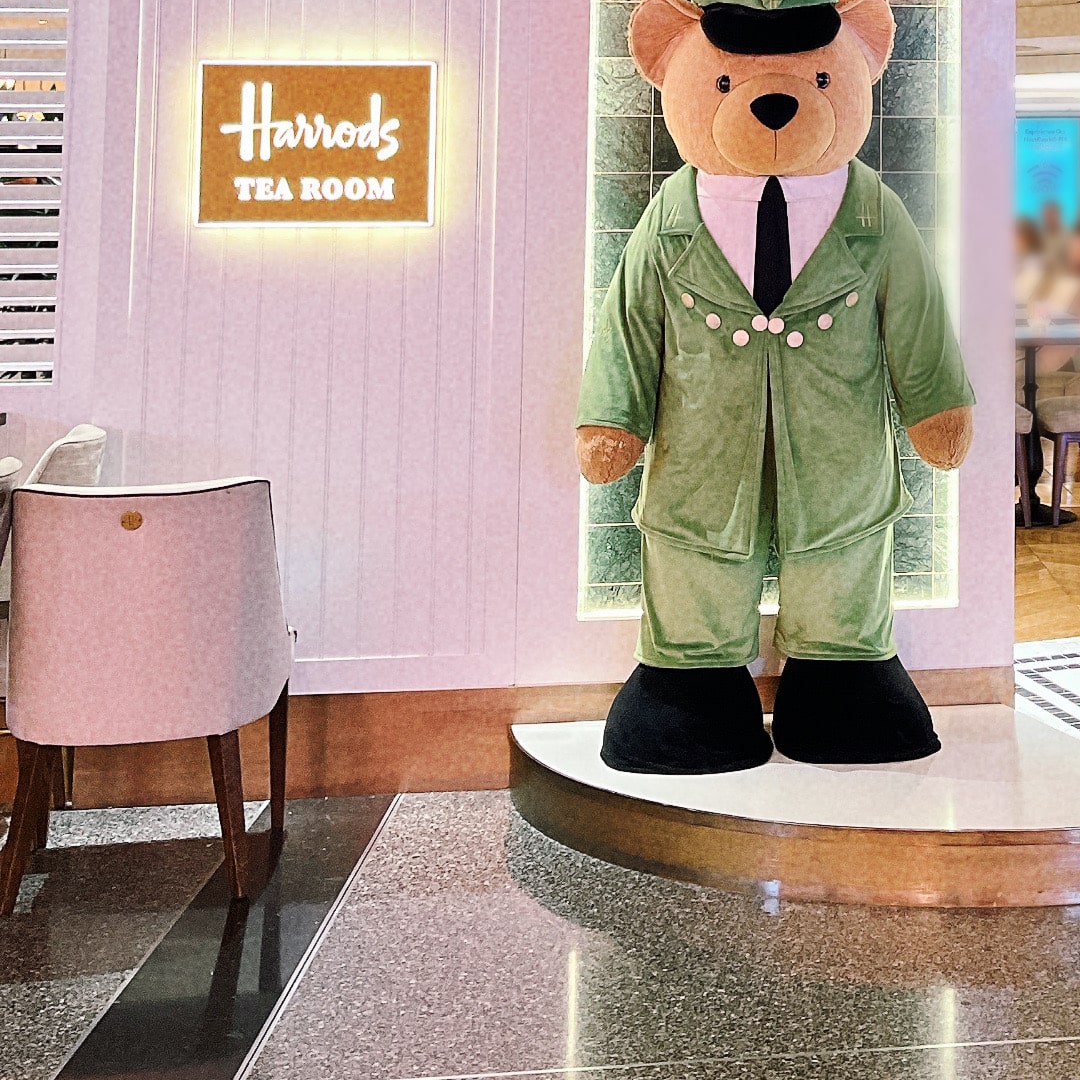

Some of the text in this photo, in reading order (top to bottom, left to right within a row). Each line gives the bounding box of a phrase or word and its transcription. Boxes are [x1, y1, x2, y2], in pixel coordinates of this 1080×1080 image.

[220, 81, 400, 161] Harrods
[234, 176, 395, 201] TEA ROOM
